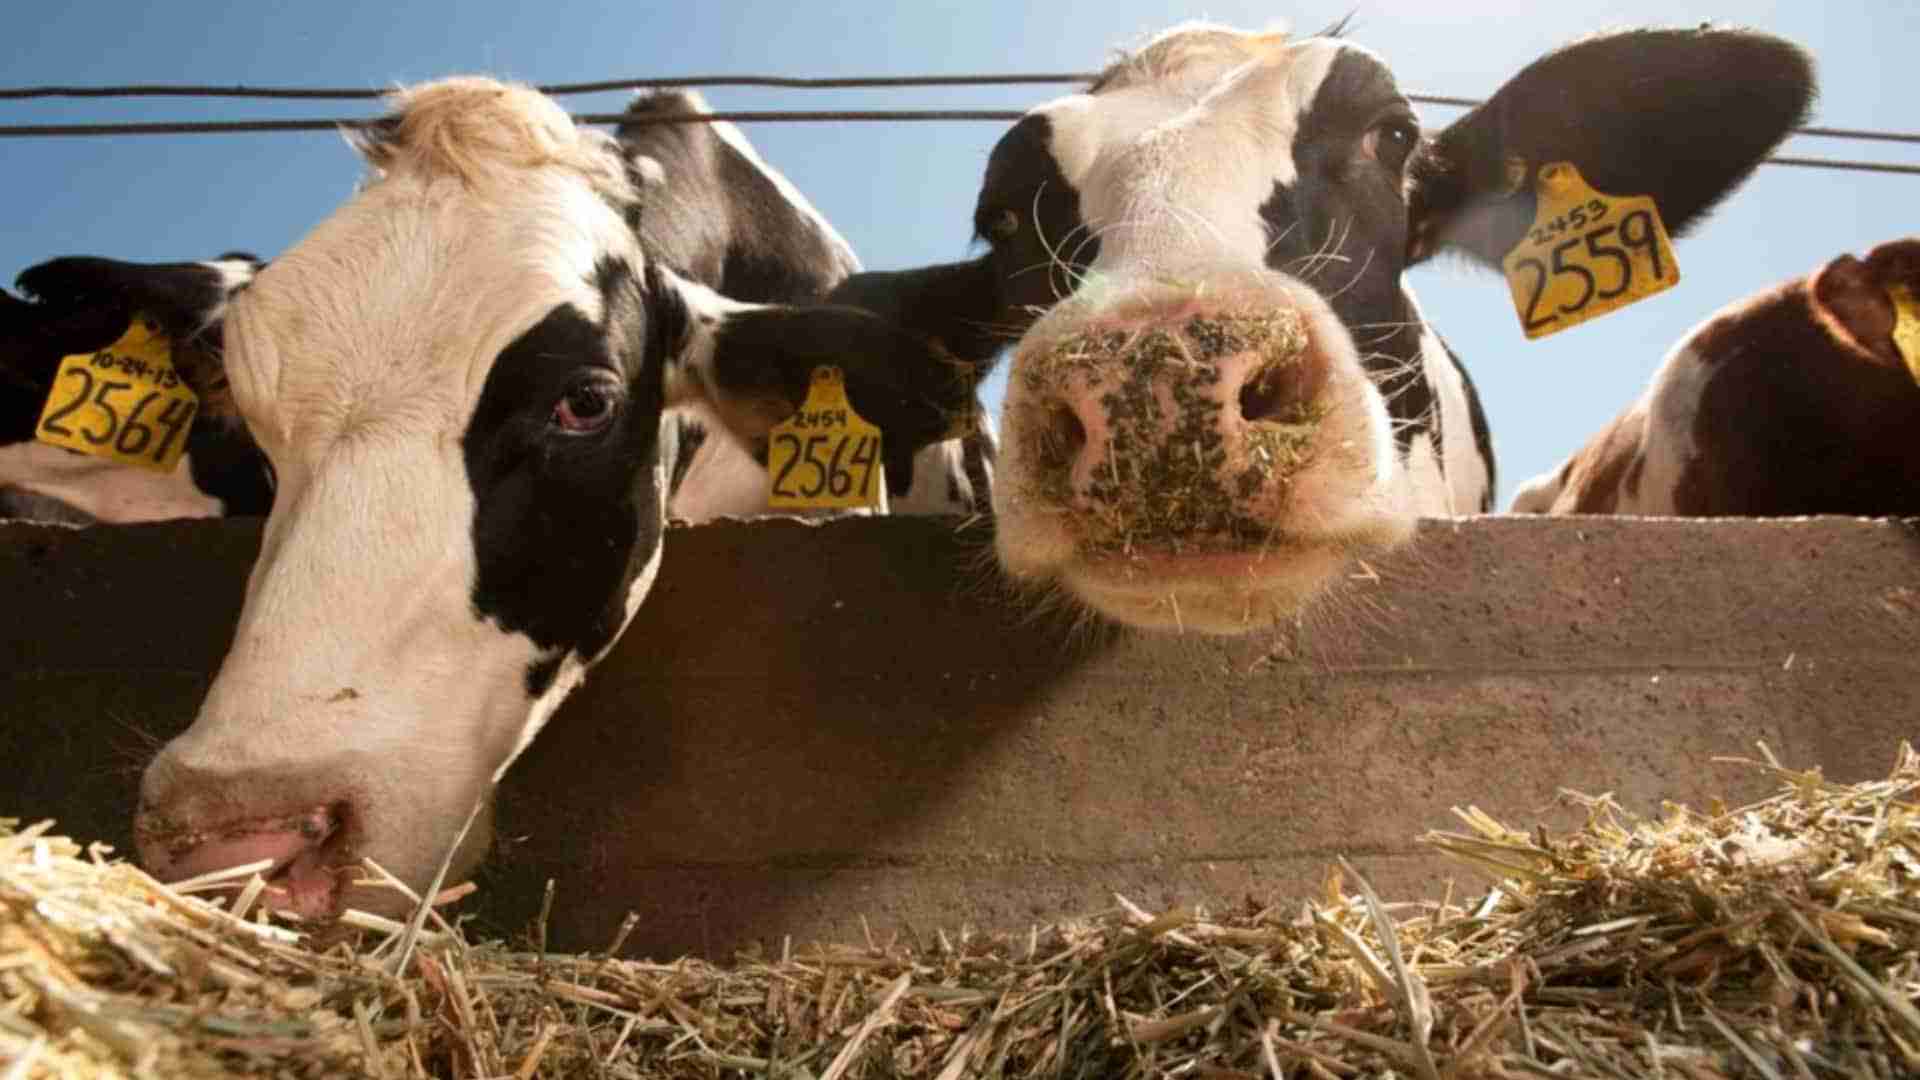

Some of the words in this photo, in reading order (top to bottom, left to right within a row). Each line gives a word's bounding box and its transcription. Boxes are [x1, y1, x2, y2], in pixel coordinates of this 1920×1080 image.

[1529, 199, 1609, 246] 2453
[1514, 209, 1662, 331] 2559
[43, 367, 196, 462] 2564
[772, 433, 880, 498] 2564
